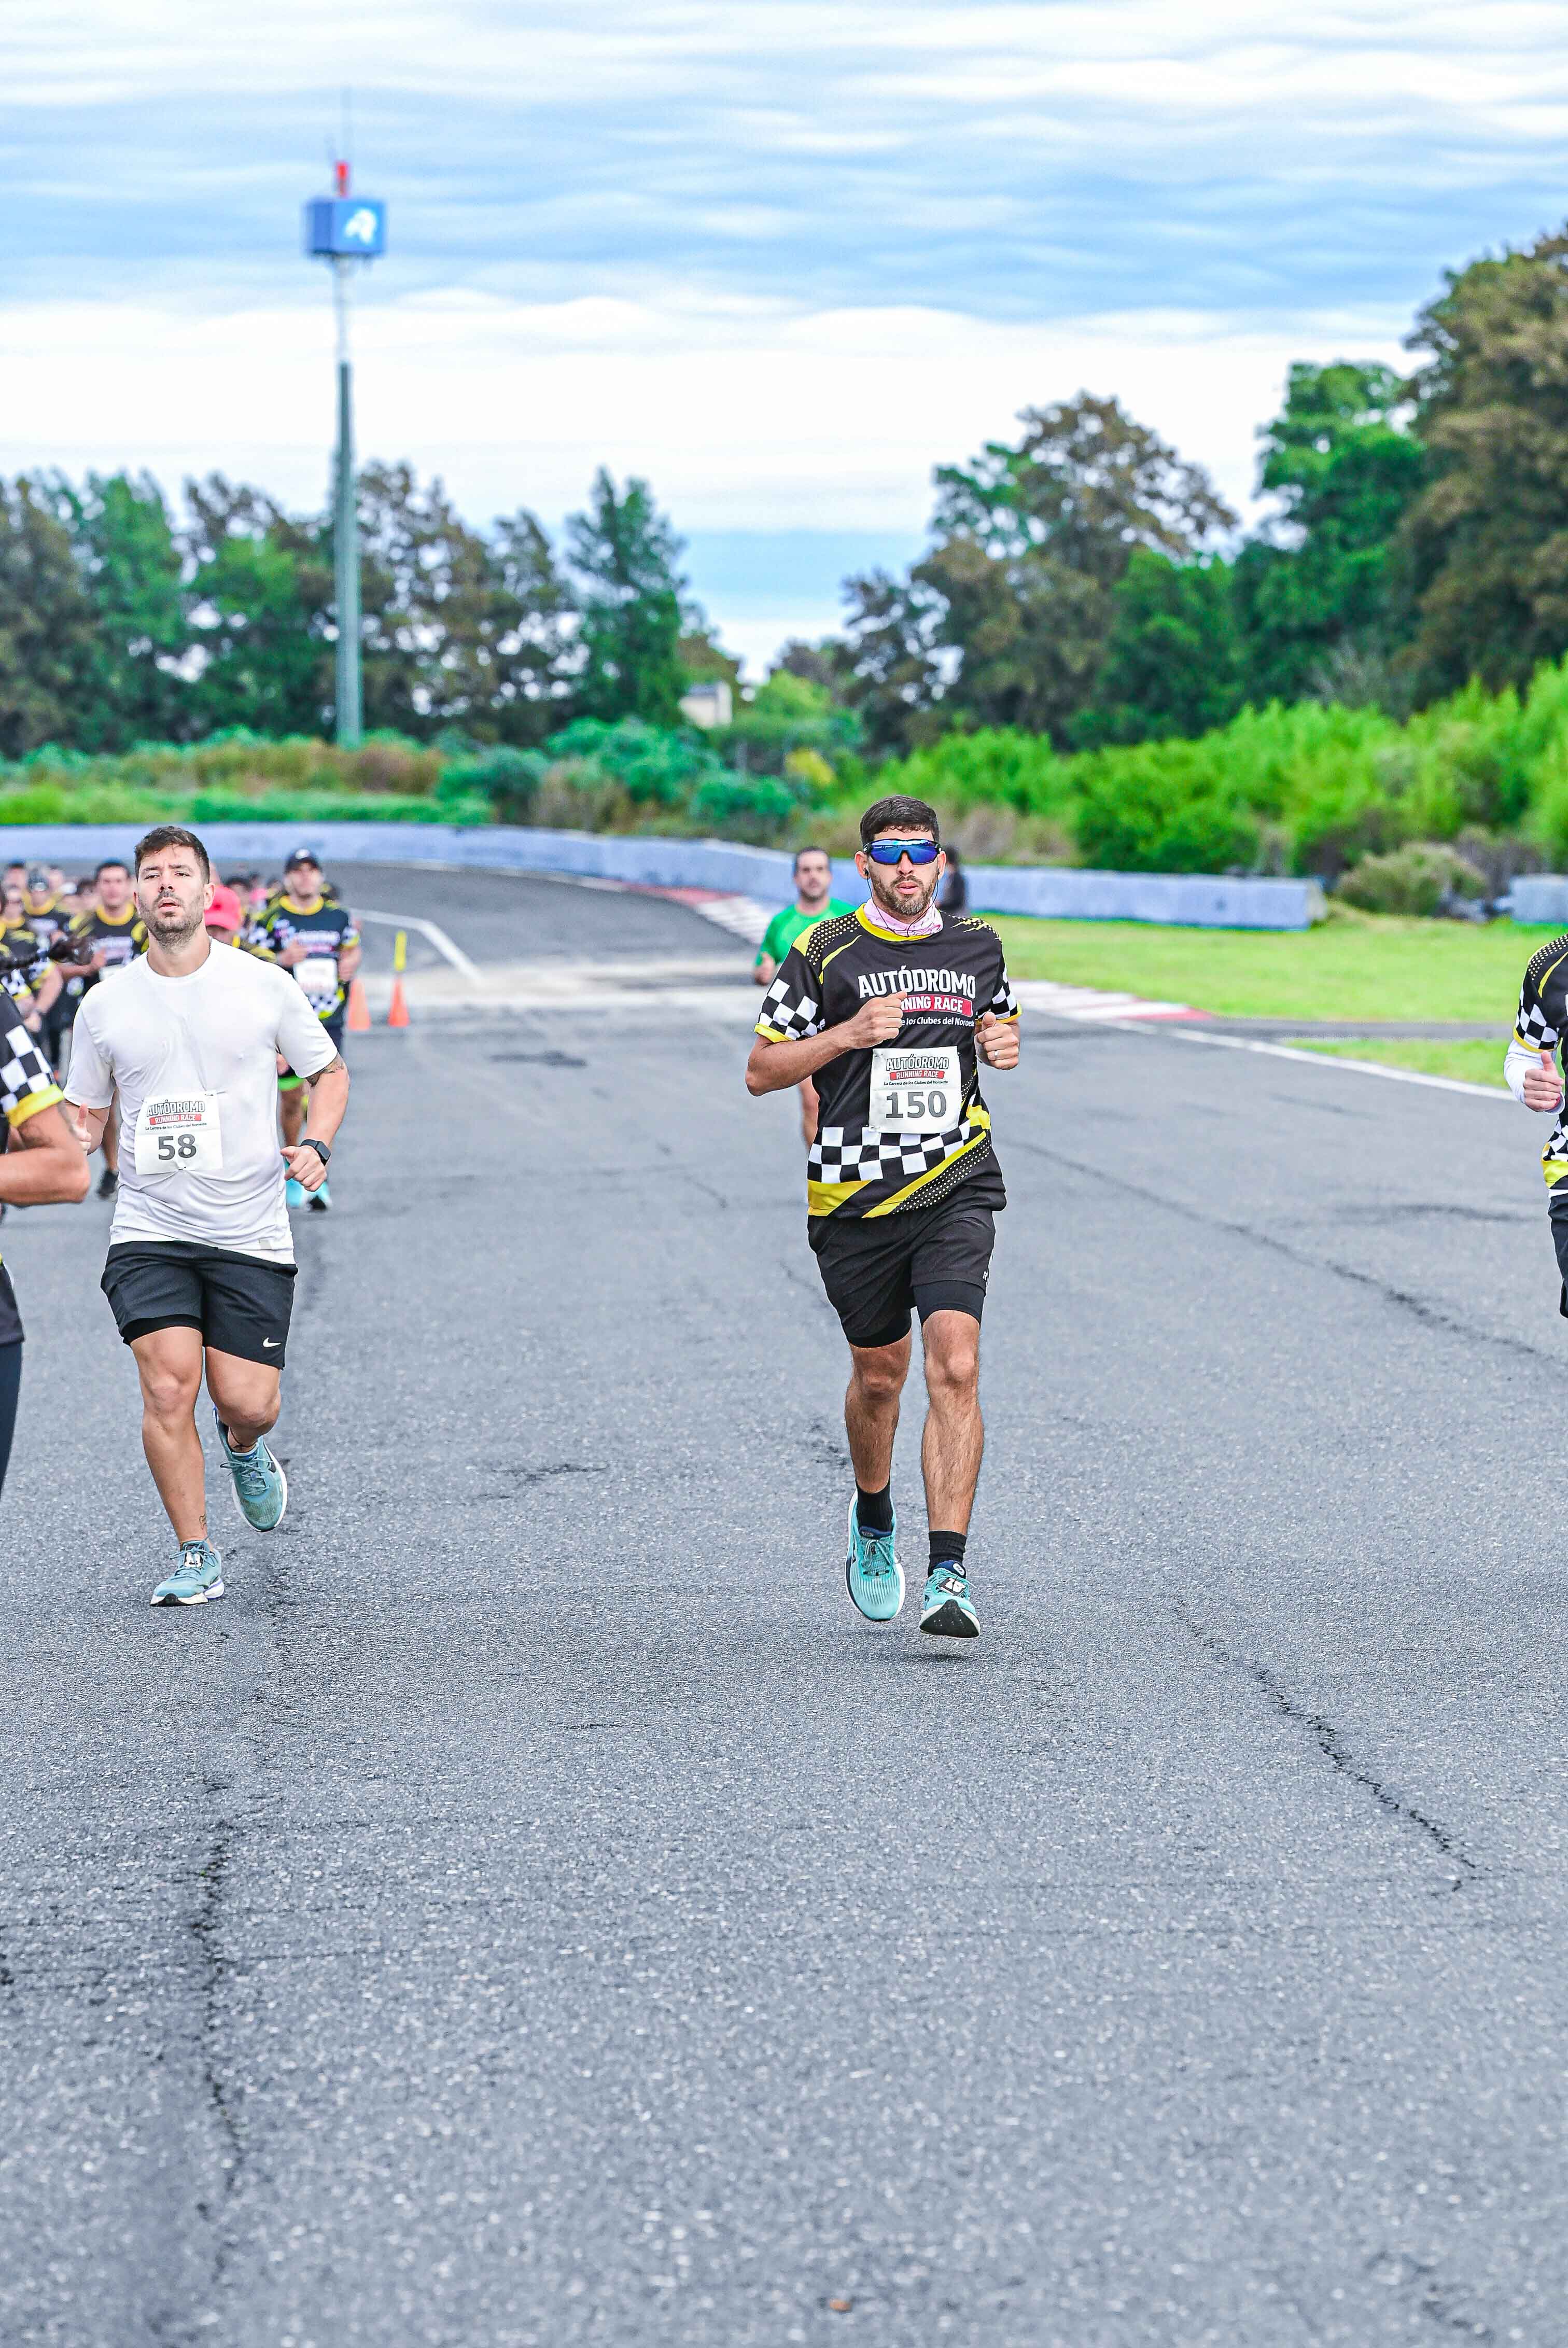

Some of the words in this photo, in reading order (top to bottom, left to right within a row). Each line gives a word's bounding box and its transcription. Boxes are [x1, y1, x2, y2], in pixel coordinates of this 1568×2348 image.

[858, 965, 976, 999] AUTÓDROMO
[901, 996, 932, 1011] NING
[934, 996, 964, 1013] RACE
[916, 1016, 941, 1025] Clubes
[942, 1016, 954, 1025] del
[886, 1053, 949, 1071] AUTÓDROMO
[895, 1070, 922, 1079] RUNNING
[923, 1070, 938, 1078] RACE
[146, 1099, 206, 1117] AUTÓDROMO
[885, 1091, 947, 1119] 150
[158, 1134, 197, 1161] 58
